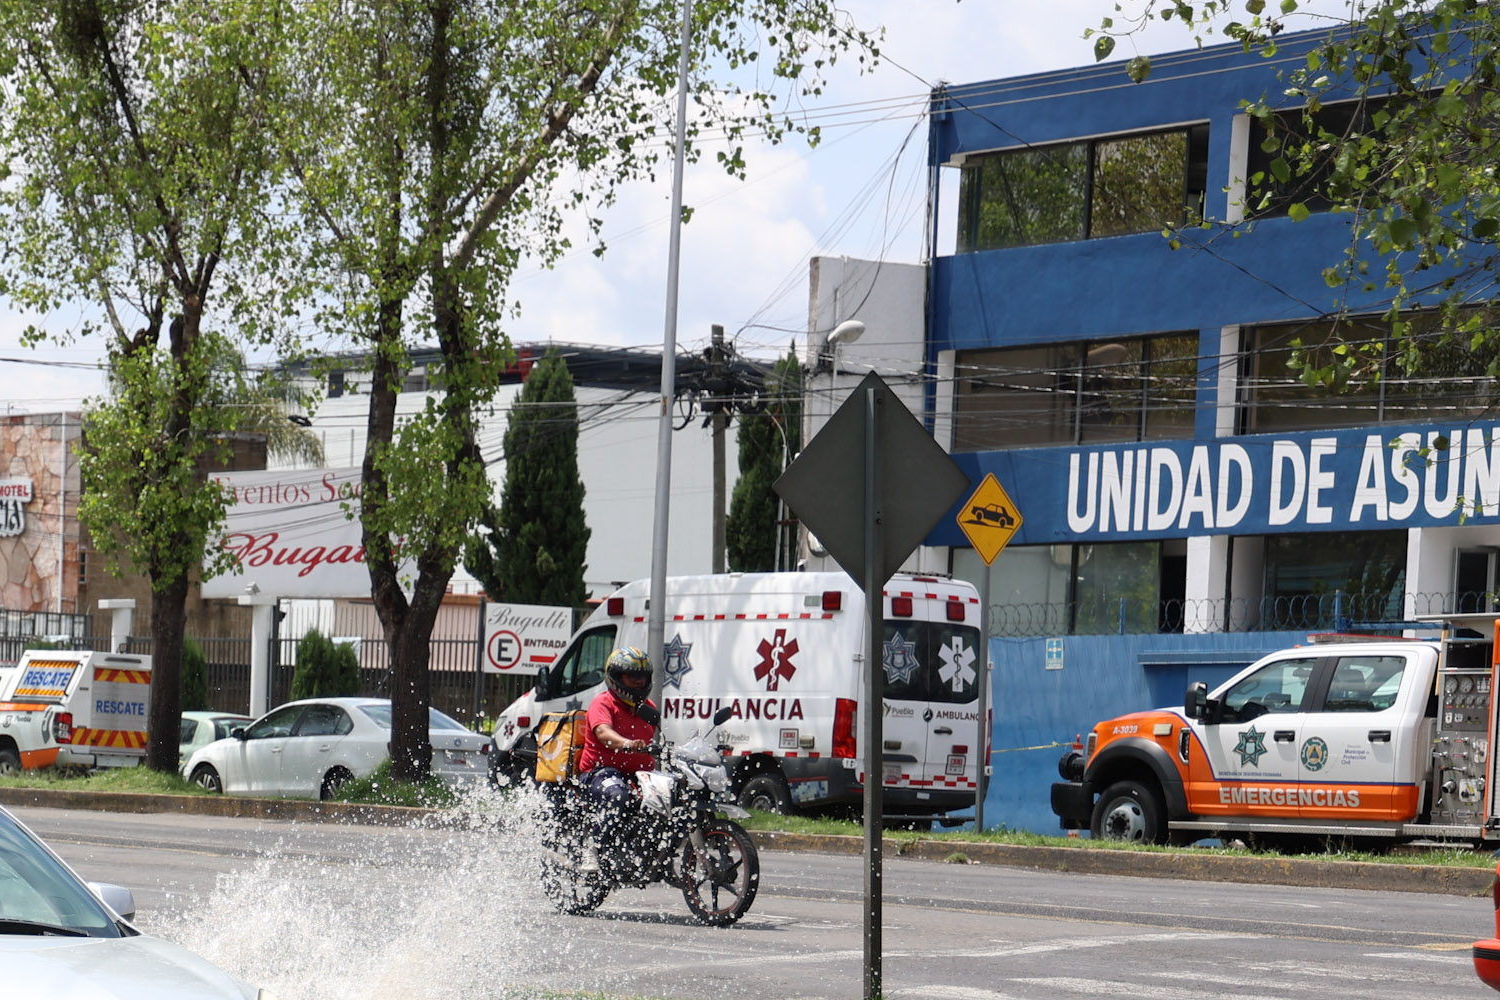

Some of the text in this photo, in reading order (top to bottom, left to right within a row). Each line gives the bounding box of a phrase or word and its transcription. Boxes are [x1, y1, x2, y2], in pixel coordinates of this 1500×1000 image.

[1067, 443, 1253, 533] UNIDAD
[1268, 437, 1338, 526] DE
[488, 605, 569, 635] Bugatti
[497, 638, 513, 662] E
[523, 638, 567, 648] ENTRADA
[23, 670, 72, 687] RESCATE
[96, 700, 145, 716] RESCATE
[1112, 724, 1138, 735] A-3039
[1219, 786, 1360, 808] EMERGENCIAS
